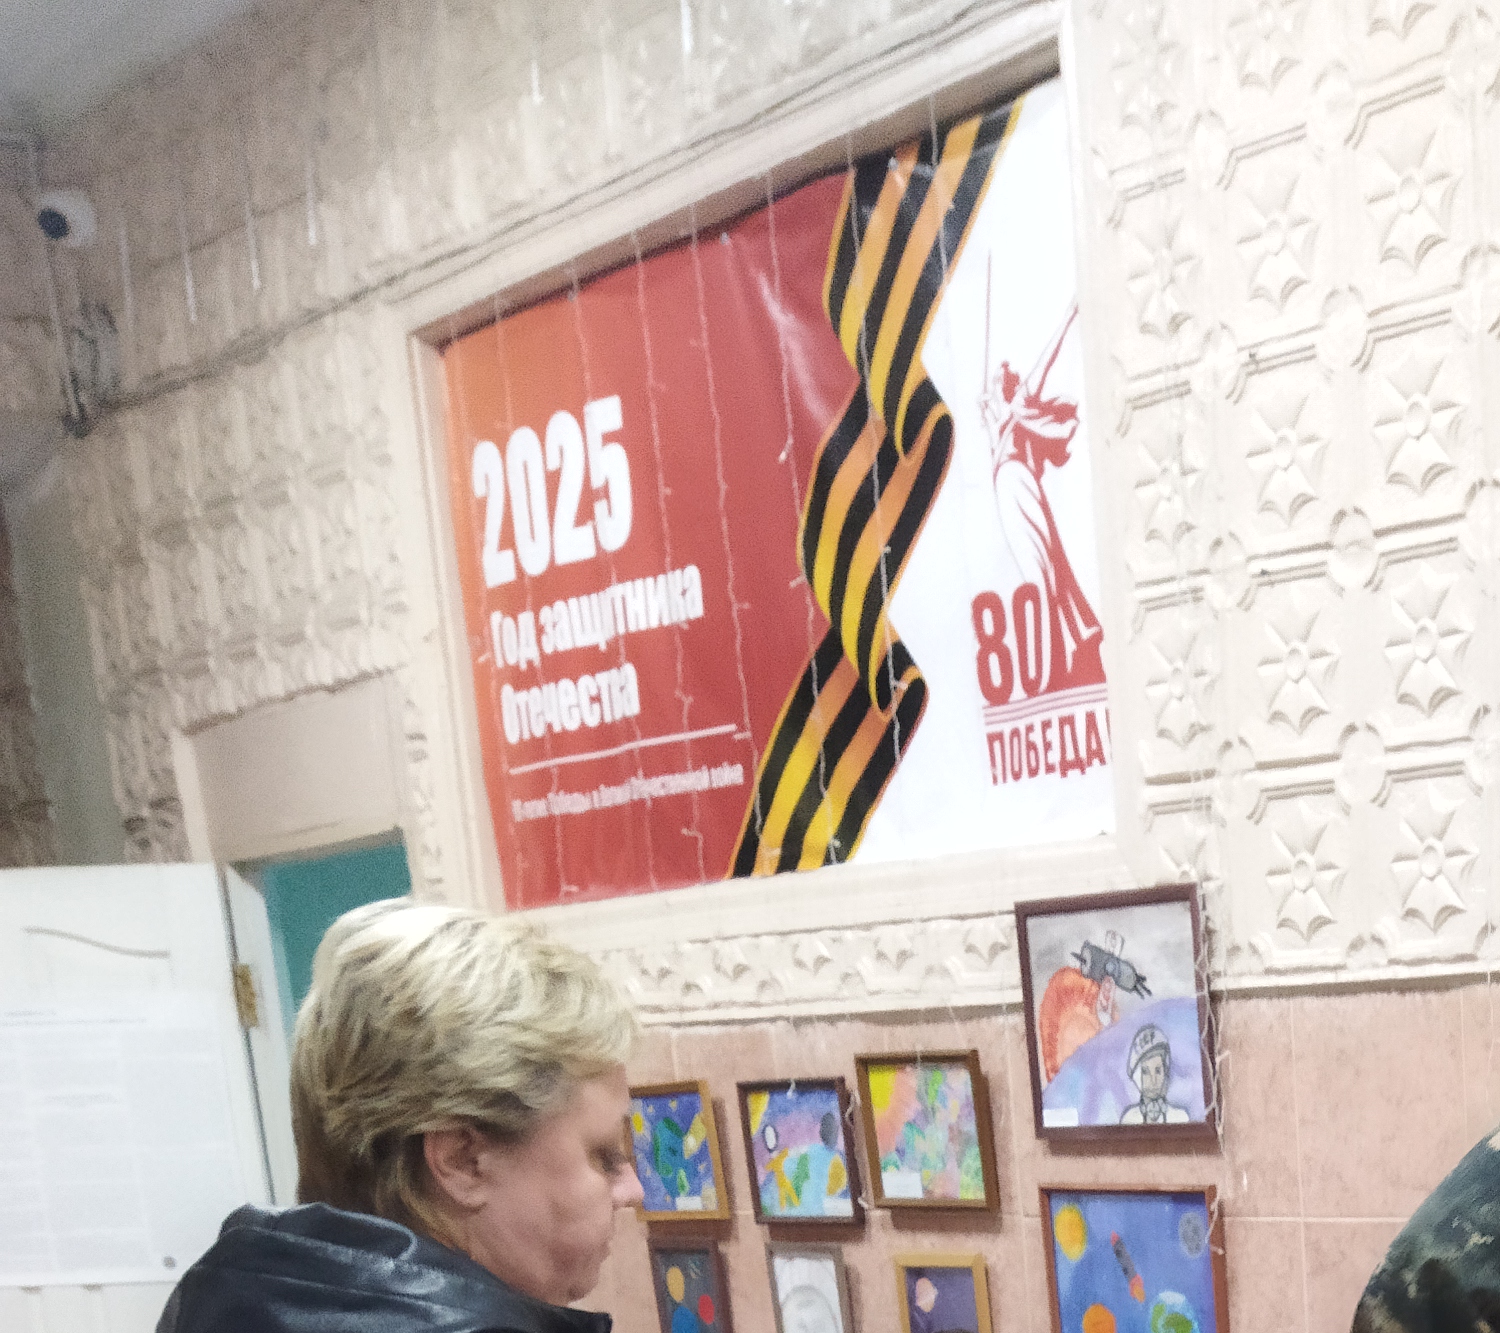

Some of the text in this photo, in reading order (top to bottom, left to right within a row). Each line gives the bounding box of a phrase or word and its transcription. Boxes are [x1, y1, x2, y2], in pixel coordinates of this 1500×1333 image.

[472, 394, 632, 589] 2025
[490, 564, 704, 671] Год защитника
[971, 582, 1044, 707] 80
[500, 663, 641, 744] Отечества
